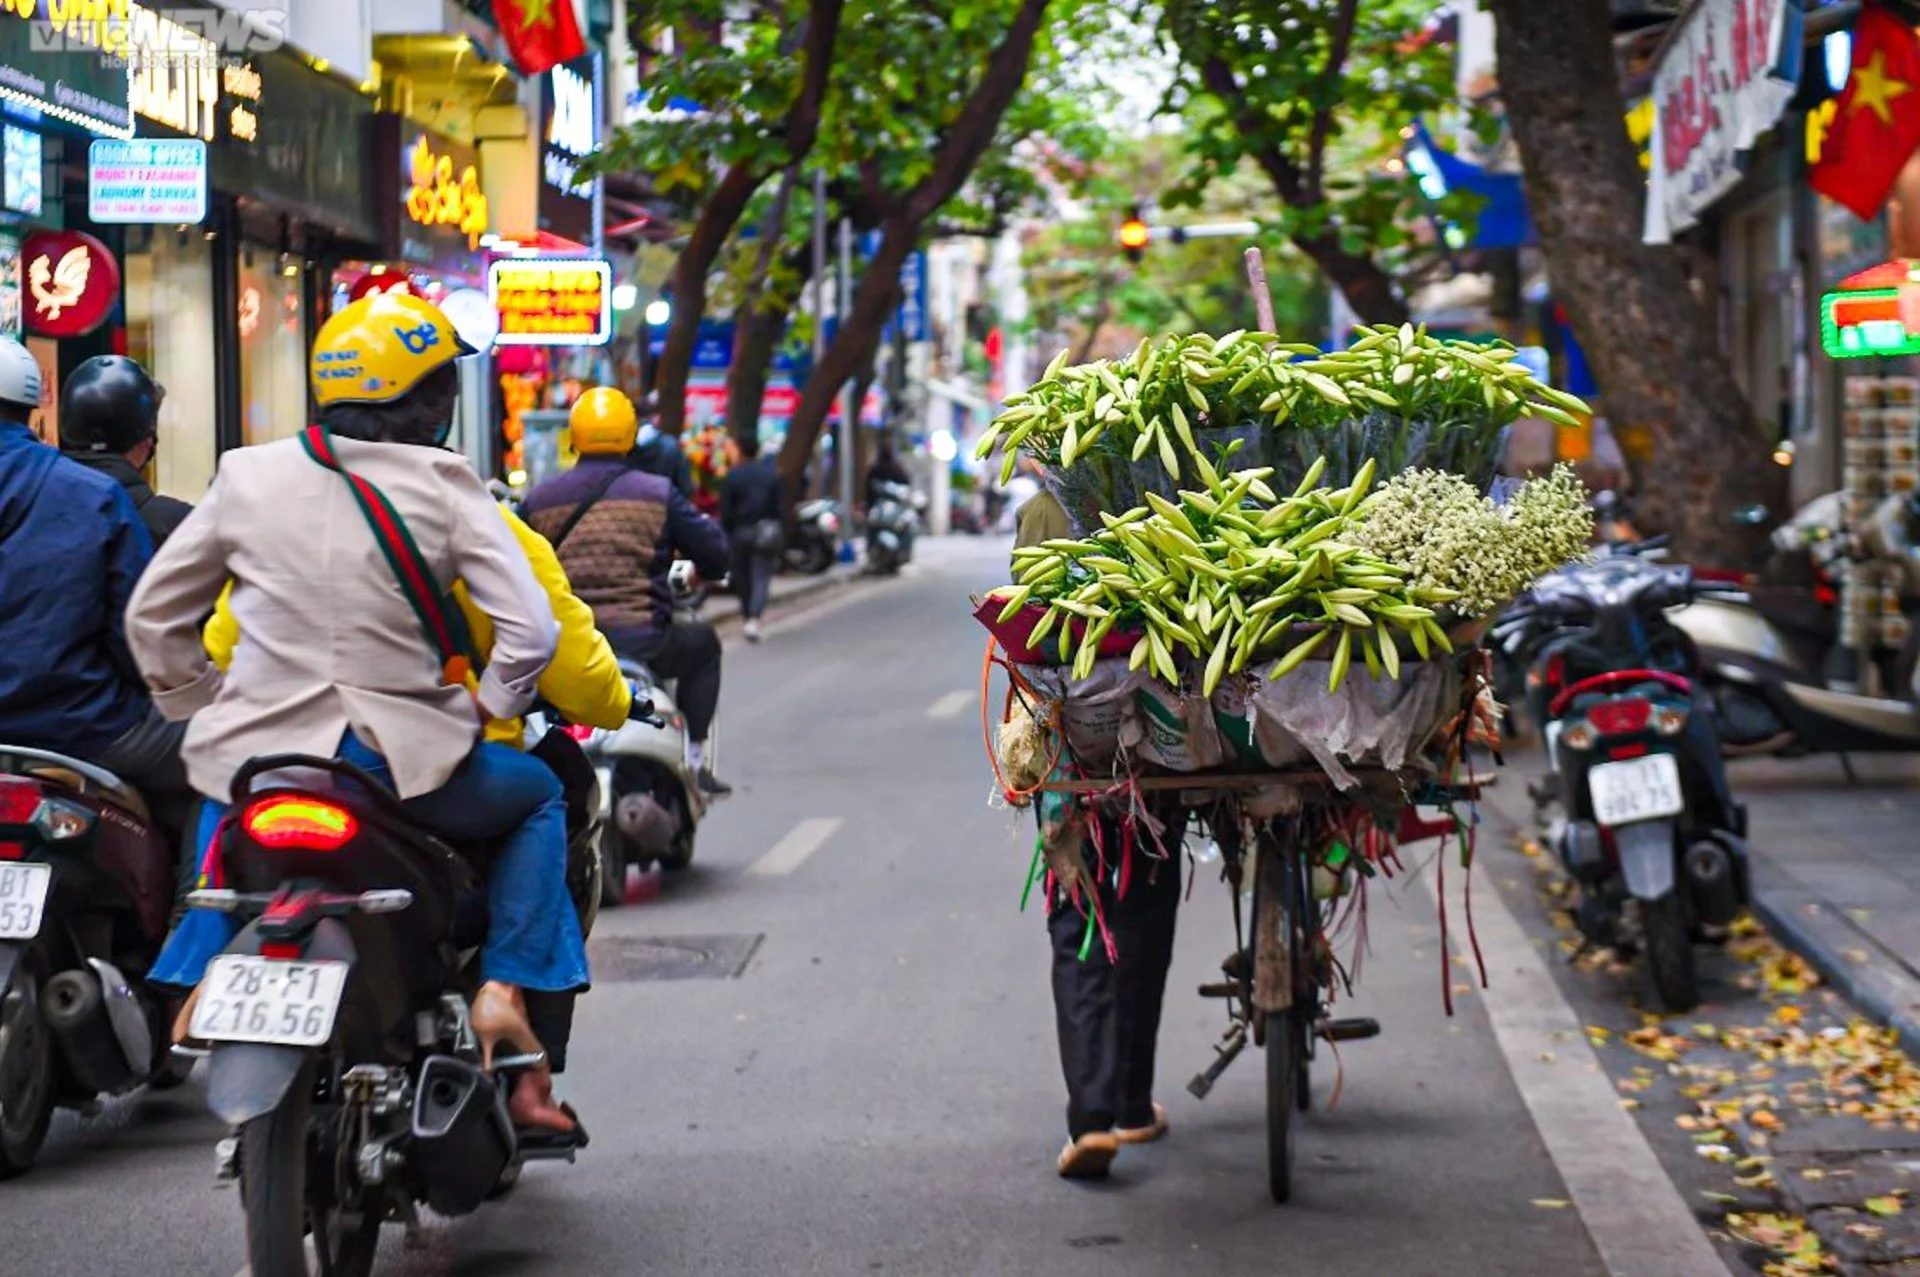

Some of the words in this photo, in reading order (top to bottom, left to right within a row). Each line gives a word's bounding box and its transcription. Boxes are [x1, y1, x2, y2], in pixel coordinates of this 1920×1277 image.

[394, 321, 440, 355] be
[225, 963, 321, 1000] 28-F1
[202, 1000, 325, 1037] 216.56
